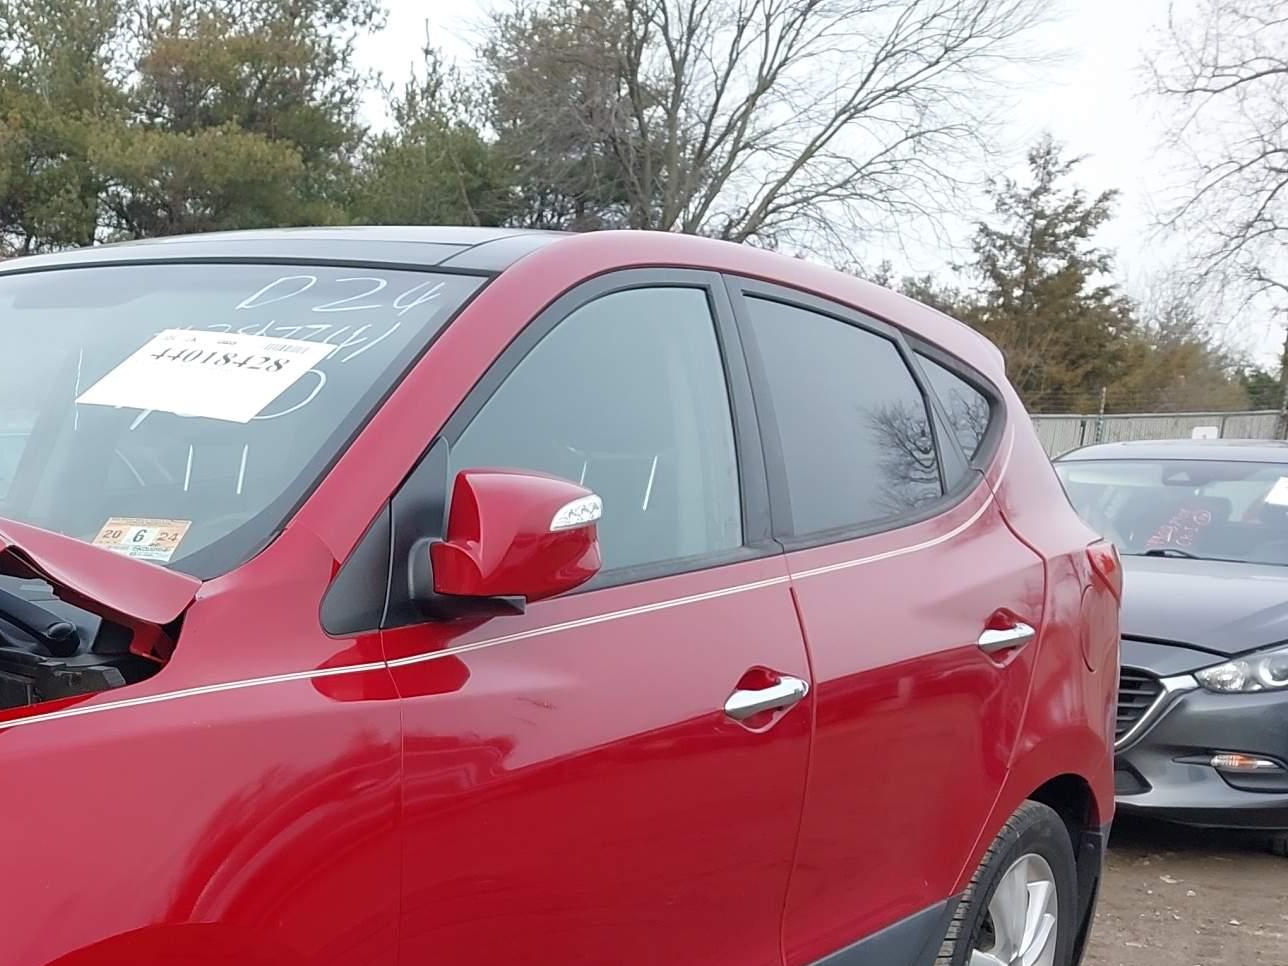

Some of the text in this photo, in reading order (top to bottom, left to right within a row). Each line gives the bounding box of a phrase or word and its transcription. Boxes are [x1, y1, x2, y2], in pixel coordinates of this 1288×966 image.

[150, 347, 290, 372] 44018428
[103, 529, 179, 543] 20 6 24
